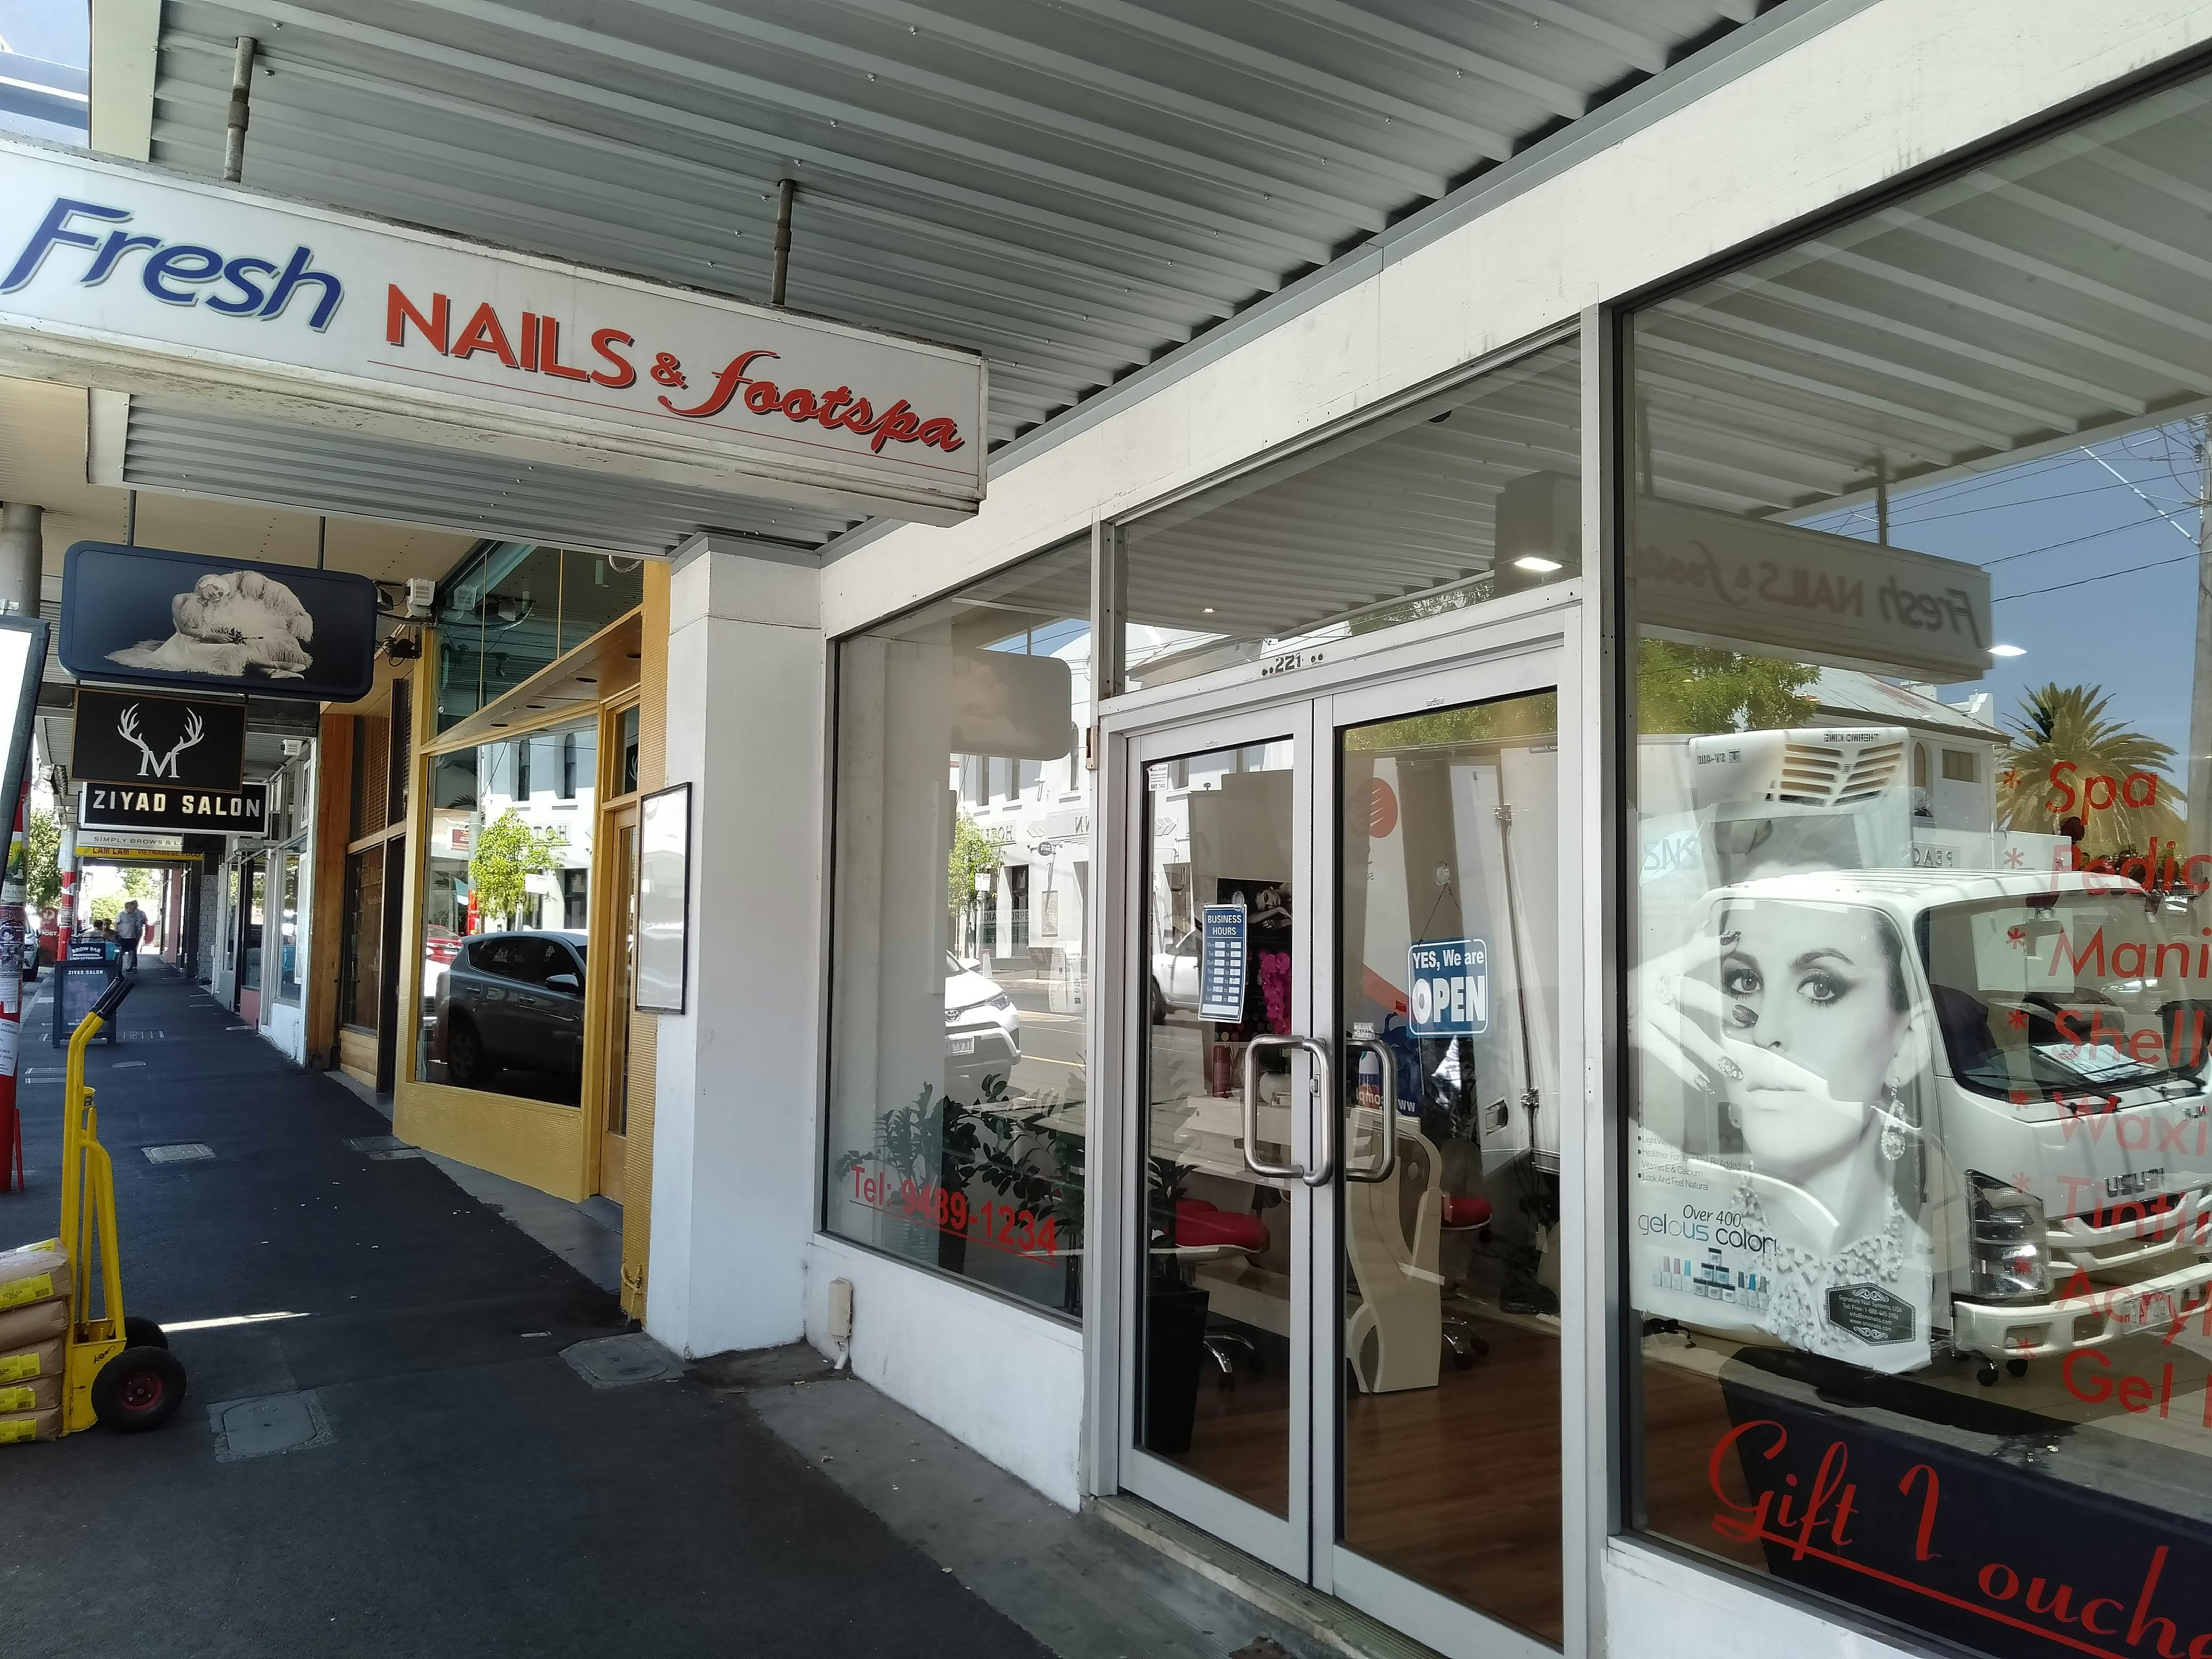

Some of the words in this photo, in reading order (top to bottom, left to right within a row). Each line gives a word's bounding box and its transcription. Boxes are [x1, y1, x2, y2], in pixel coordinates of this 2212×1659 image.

[1, 197, 344, 333] Fresh
[384, 283, 636, 389] NAILS
[650, 351, 686, 389] &
[658, 349, 966, 454] footspa
[1276, 652, 1302, 673] 221
[93, 790, 166, 812] ZIYAD
[182, 795, 260, 817] SALON
[2045, 761, 2158, 825] Spa
[130, 837, 162, 845] BROWS
[1644, 838, 1700, 870] SNS
[1208, 915, 1242, 924] BUSINESS
[1212, 927, 1236, 935] HOURS
[1412, 951, 1440, 971] YES,
[1443, 949, 1461, 967] We
[1464, 950, 1484, 966] are
[1412, 975, 1486, 1024] OPEN
[2051, 1008, 2212, 1068] Shell
[1642, 1136, 1657, 1146] Light
[1642, 1148, 1669, 1160] Healthier
[1719, 1159, 1741, 1170] Added
[1665, 1164, 1670, 1173] E
[1671, 1164, 1676, 1173] &
[1677, 1166, 1703, 1178] Calcium
[1642, 1172, 1658, 1183] Look
[1658, 1175, 1671, 1184] And
[1671, 1177, 1685, 1187] Feel
[1685, 1179, 1710, 1191] Natural
[851, 1165, 892, 1206] Tel:
[903, 1179, 1058, 1258] 9489-1234
[1683, 1204, 1714, 1222] Over
[1716, 1210, 1741, 1228] 400
[1638, 1213, 1710, 1242] gelous
[1715, 1228, 1778, 1256] color!
[1838, 1294, 1861, 1305] Signature
[2062, 1348, 2174, 1419] Gel
[1708, 1420, 1859, 1561] Gift
